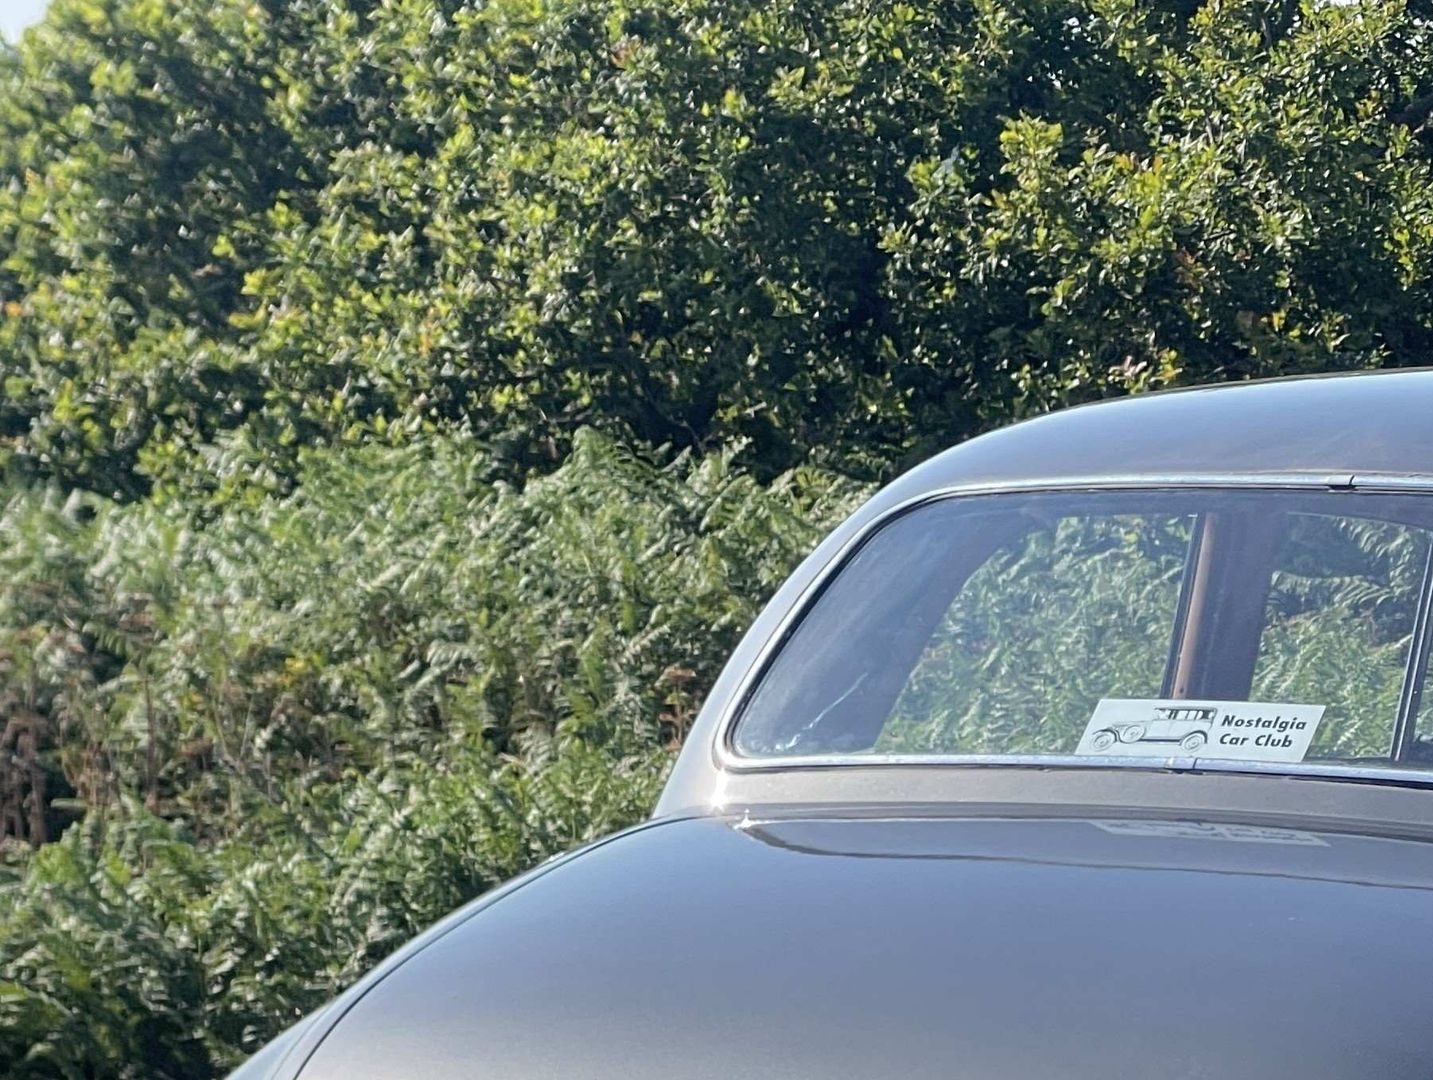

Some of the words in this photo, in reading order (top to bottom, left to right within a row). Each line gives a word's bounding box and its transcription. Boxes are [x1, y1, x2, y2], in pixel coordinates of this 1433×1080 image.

[1221, 714, 1307, 731] Nostalgia
[1219, 733, 1249, 746] Car
[1255, 734, 1293, 748] Club
